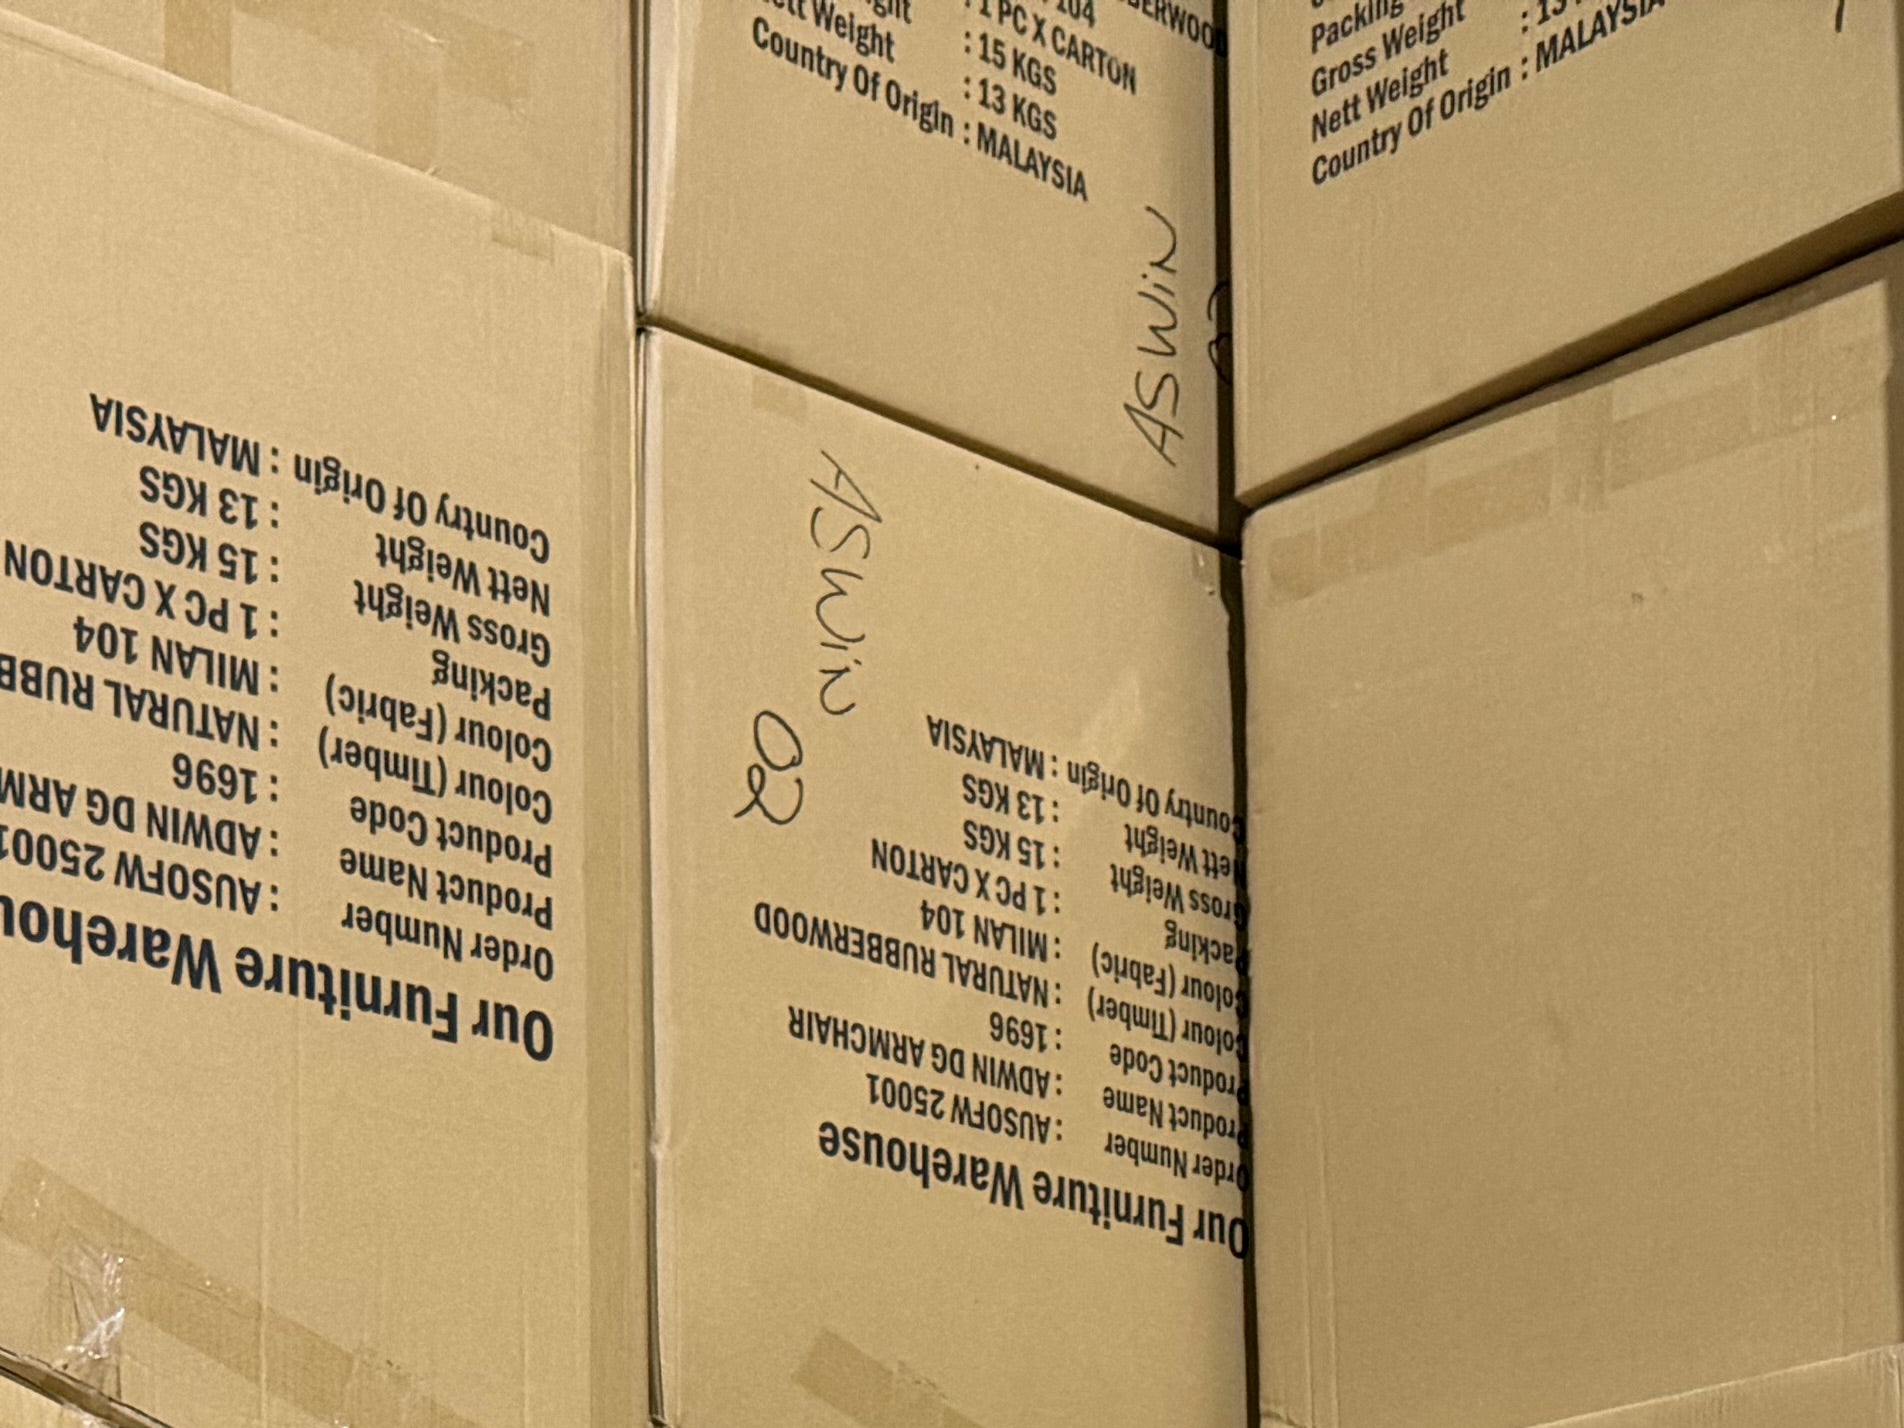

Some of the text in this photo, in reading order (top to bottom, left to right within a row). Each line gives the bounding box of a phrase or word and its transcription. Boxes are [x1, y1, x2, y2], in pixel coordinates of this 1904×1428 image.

[813, 0, 895, 63] Weight
[978, 77, 1006, 116] 13
[1012, 94, 1057, 140] KGS
[978, 32, 1057, 96] 15 KGS
[998, 3, 1029, 36] PC
[1031, 16, 1047, 45] X
[1052, 30, 1138, 95] CARTON
[1312, 0, 1466, 97] Gross Weight
[1312, 48, 1449, 144] Nett Weight
[753, 16, 1088, 202] Country Of Origin MALAYSIA
[1312, 121, 1402, 186] Country
[1408, 99, 1434, 137] Of
[1440, 65, 1511, 121] Origin
[89, 392, 550, 565] Country Of Origin MALAYSIA
[4, 539, 551, 722] Packing 1 PC X CARTON
[138, 521, 551, 668] Gross Weight 15 KGS
[103, 678, 259, 752] NATURAL
[318, 725, 448, 799] (Timber)
[926, 714, 1045, 781] MALAYSIA
[172, 752, 552, 879] Product Code 1696
[454, 769, 553, 825] Colour
[961, 772, 1199, 875] Weight 13 KGS
[1066, 760, 1132, 809] Origin
[1135, 783, 1161, 818] Of
[871, 837, 1046, 917] 1 PC X CARTON
[962, 819, 1185, 915] Weight 15 KGS
[234, 946, 458, 1044] Furniture
[753, 901, 1177, 1044] (Timber) NATURAL RUBBERWOOD
[919, 899, 1176, 1000] (Fabric) MILAN 104
[471, 998, 554, 1062] Our
[787, 1005, 1164, 1129] Name ADWIN DG ARMCHAIR
[989, 1011, 1164, 1084] Code 1696
[865, 1072, 946, 1121] 25001
[949, 1093, 1052, 1145] AUSOFW
[818, 1121, 1250, 1260] Our Furniture Warehouse
[1103, 1131, 1188, 1180] Number
